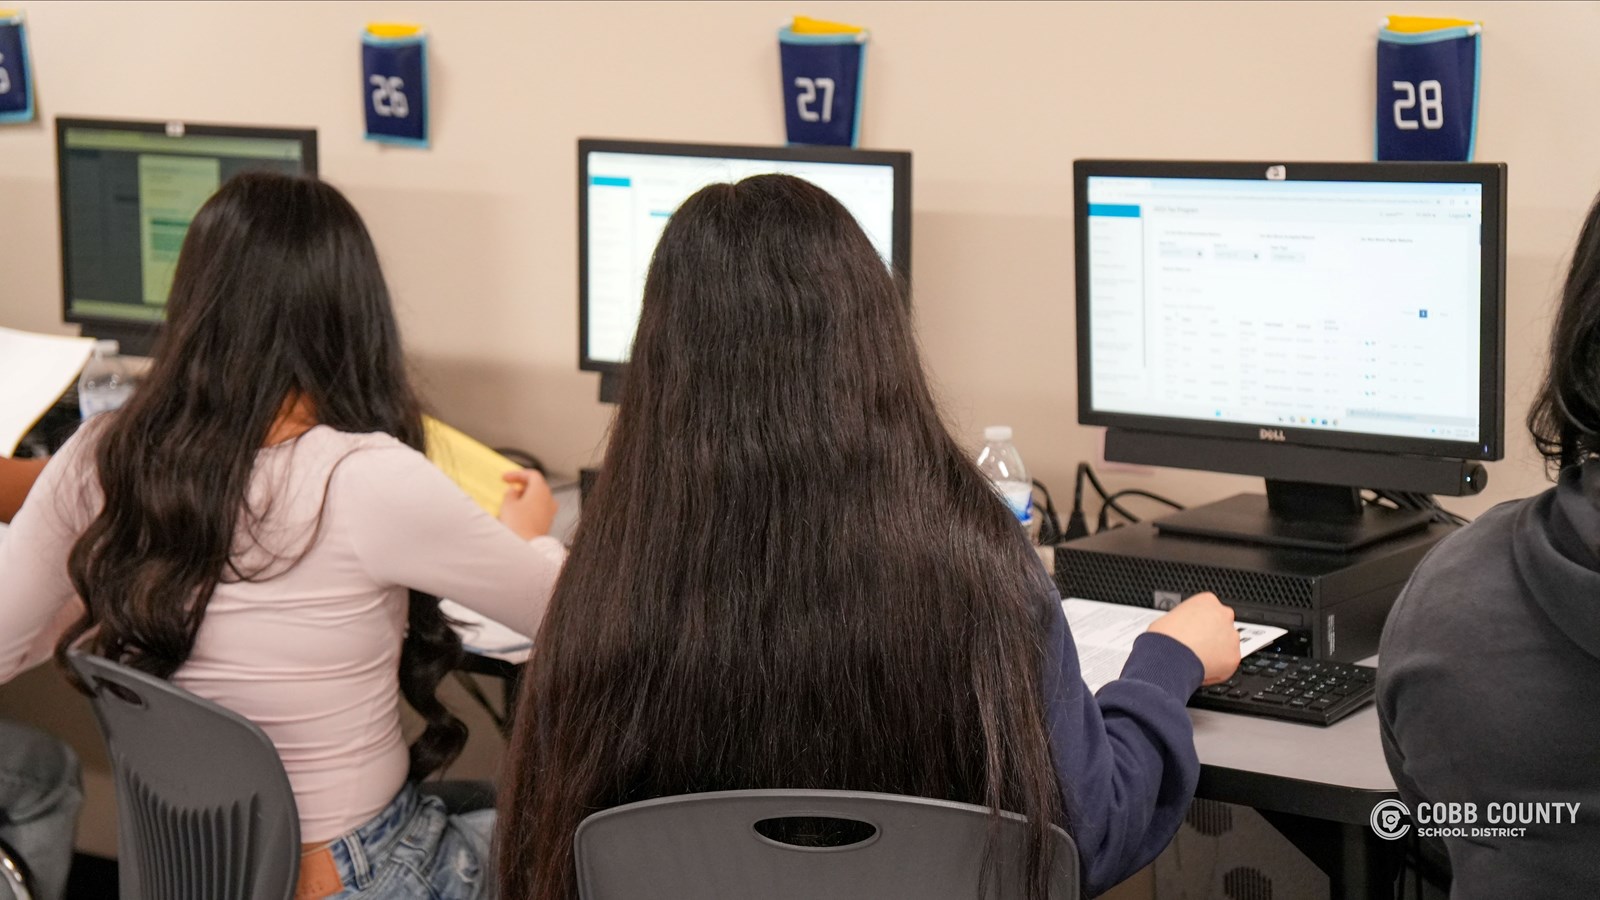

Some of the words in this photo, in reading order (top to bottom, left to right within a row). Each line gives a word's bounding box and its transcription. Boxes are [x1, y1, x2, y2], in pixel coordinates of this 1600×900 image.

[369, 73, 410, 118] 26
[794, 76, 835, 123] 27
[1392, 79, 1444, 130] 28
[1259, 428, 1286, 442] DELL
